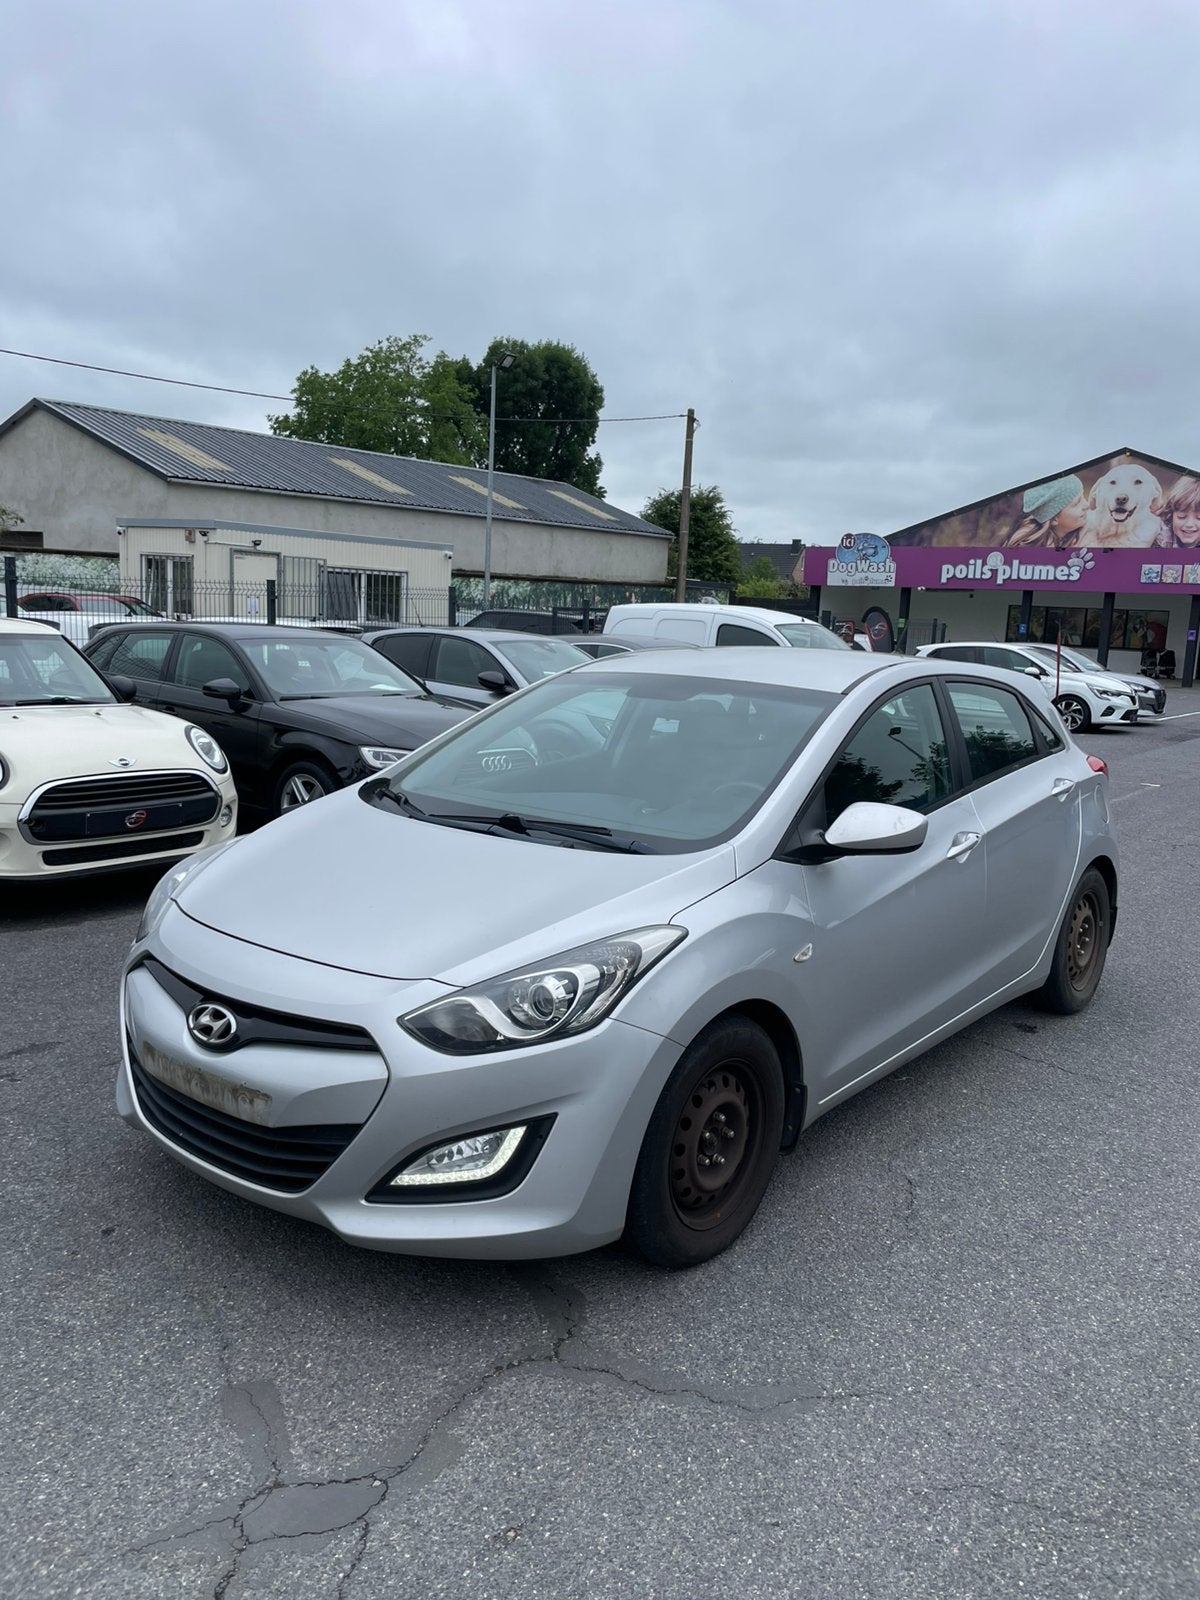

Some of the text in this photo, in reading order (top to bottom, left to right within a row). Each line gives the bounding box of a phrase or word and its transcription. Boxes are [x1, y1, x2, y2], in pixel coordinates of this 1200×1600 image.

[842, 536, 855, 547] ici
[941, 559, 992, 584] poils
[996, 559, 1081, 585] plumes
